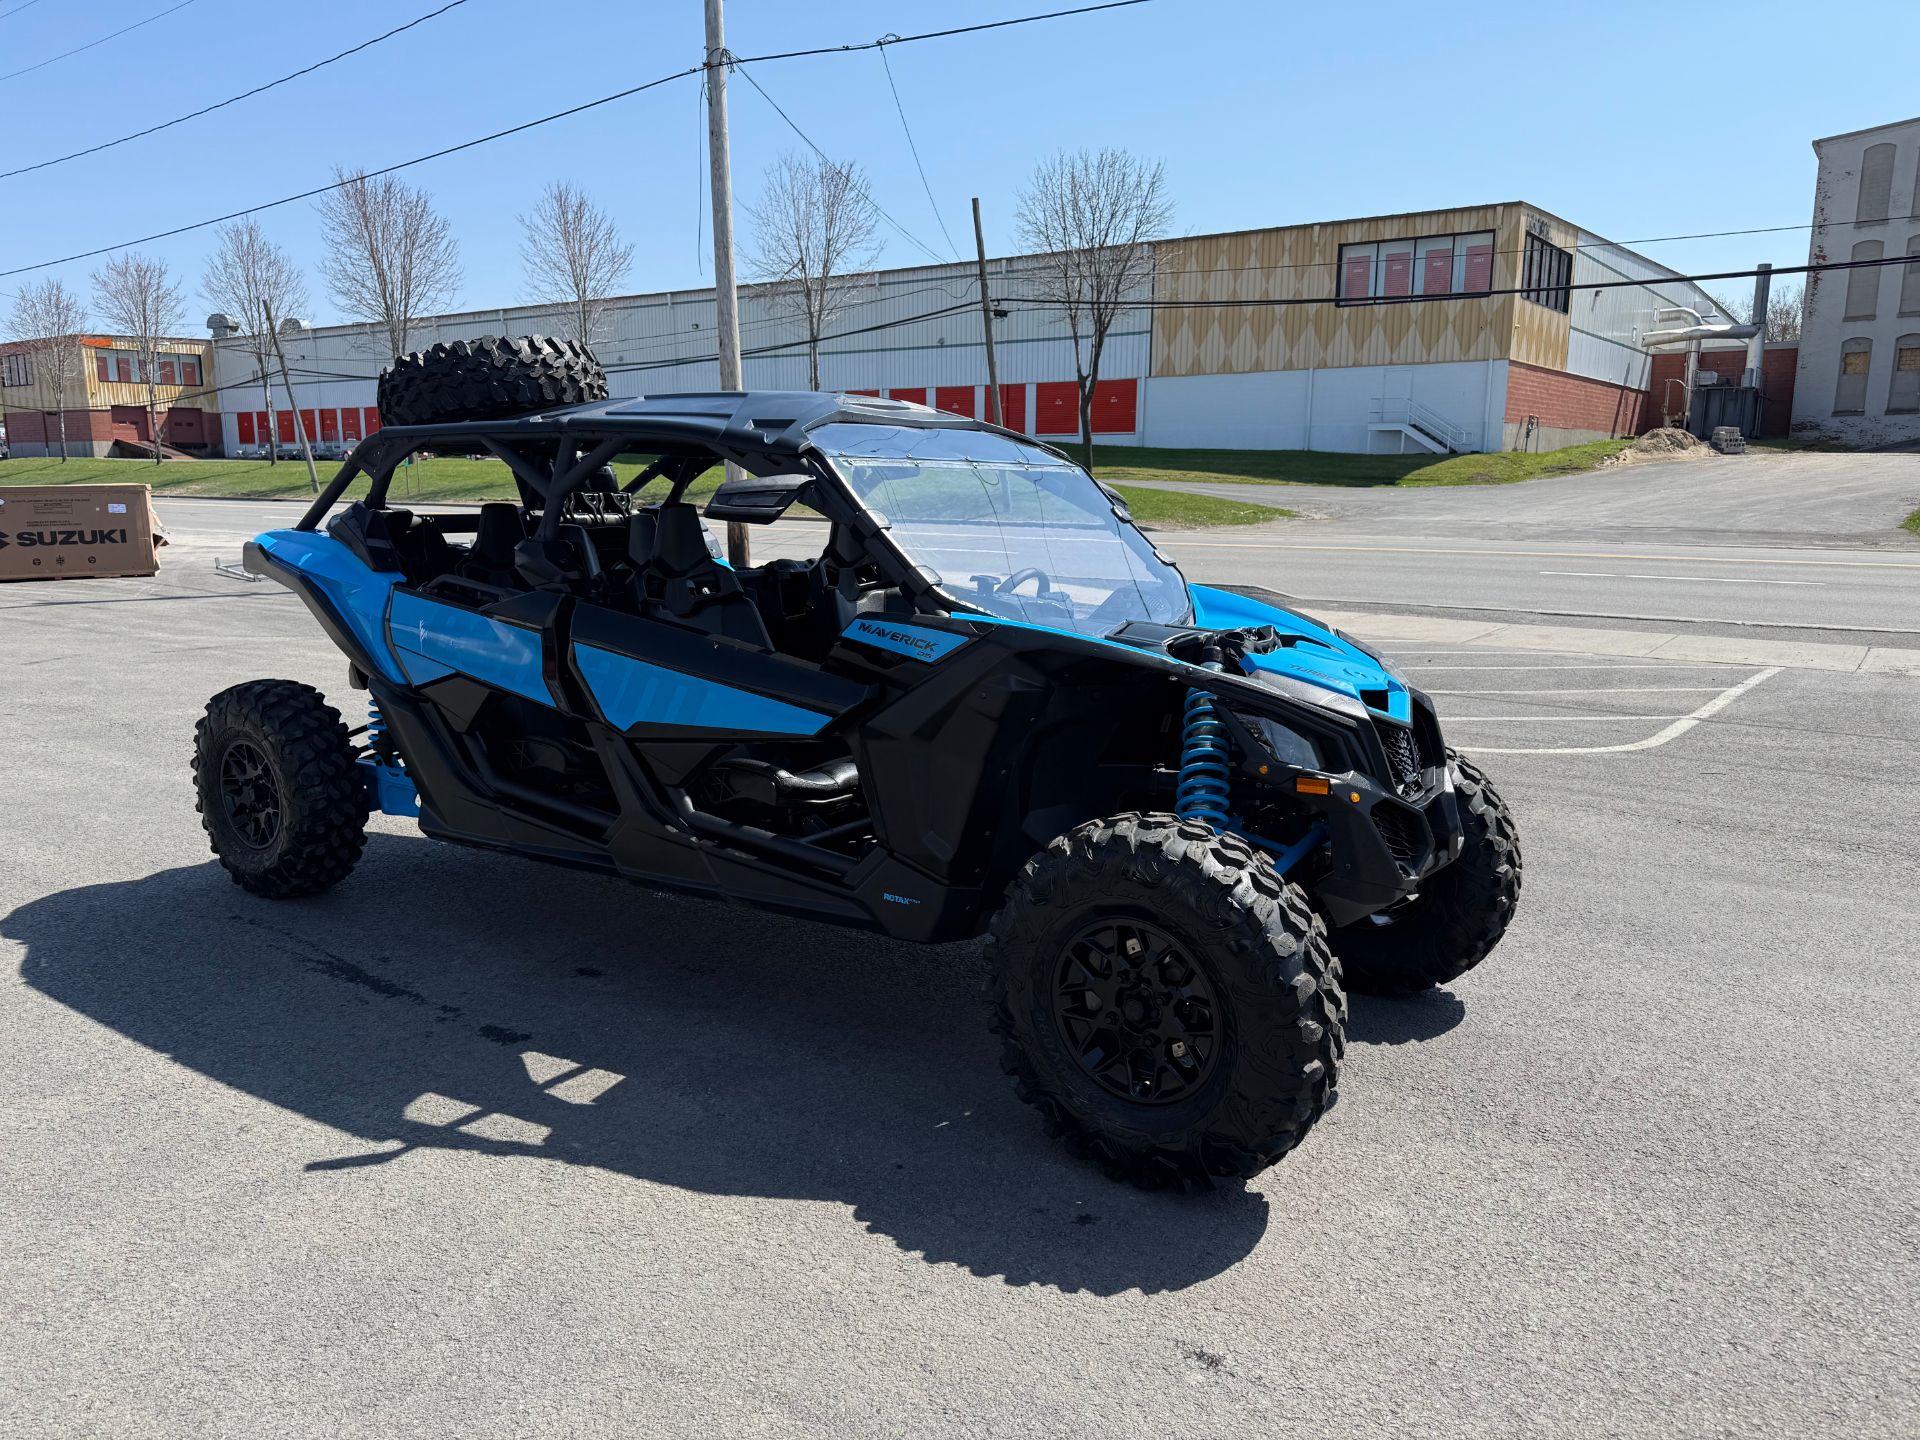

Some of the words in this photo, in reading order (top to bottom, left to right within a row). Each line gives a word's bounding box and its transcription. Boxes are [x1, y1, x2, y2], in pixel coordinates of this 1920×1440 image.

[16, 528, 127, 547] SUZUKI
[858, 622, 939, 652] MAVERICK
[883, 893, 909, 904] ROTAX
